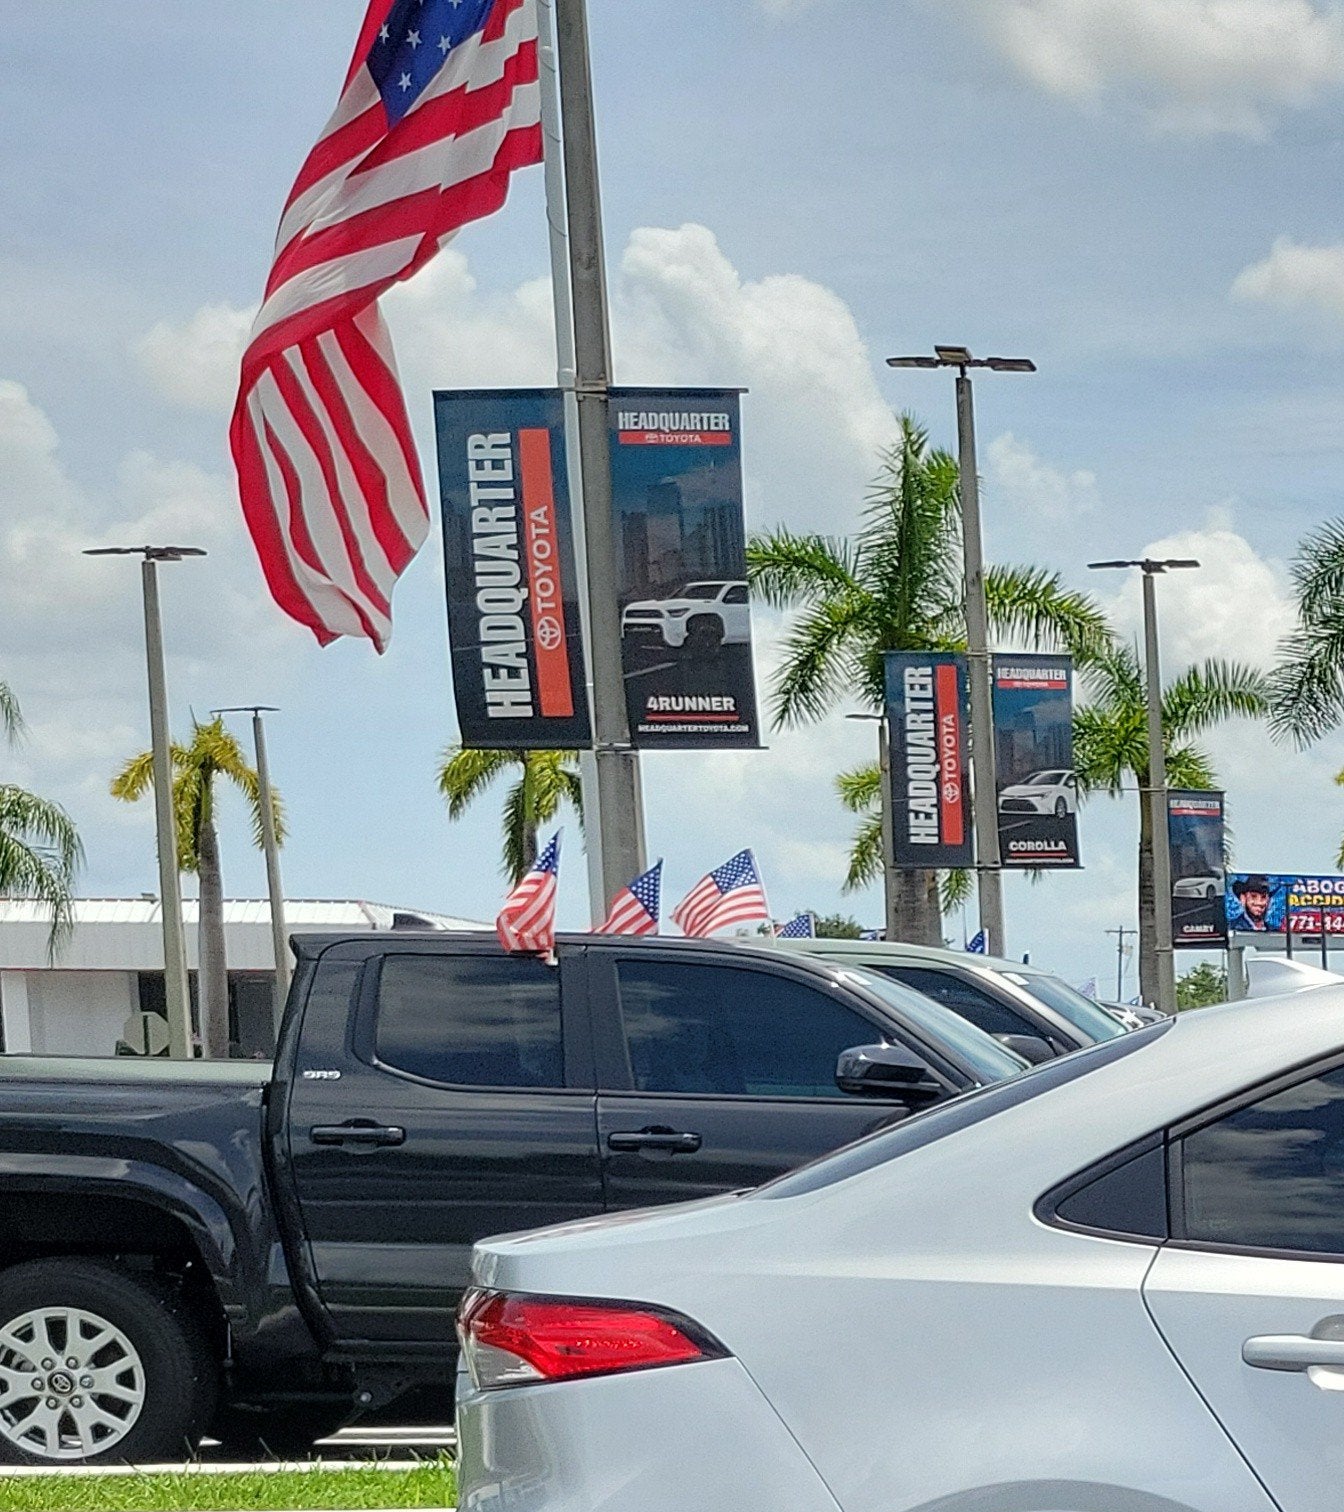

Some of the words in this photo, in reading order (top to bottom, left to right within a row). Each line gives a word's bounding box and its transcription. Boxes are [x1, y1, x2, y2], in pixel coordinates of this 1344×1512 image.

[618, 411, 730, 432] HEADQUARTER
[660, 434, 702, 442] TOYOTA
[467, 432, 535, 719] HEADQUARTER
[530, 505, 563, 613] TOYOTA
[646, 696, 736, 711] 4RUNNER
[904, 665, 941, 845] HEADQUARTER
[942, 714, 958, 779] TOYOTA
[1008, 840, 1067, 852] COROLLA
